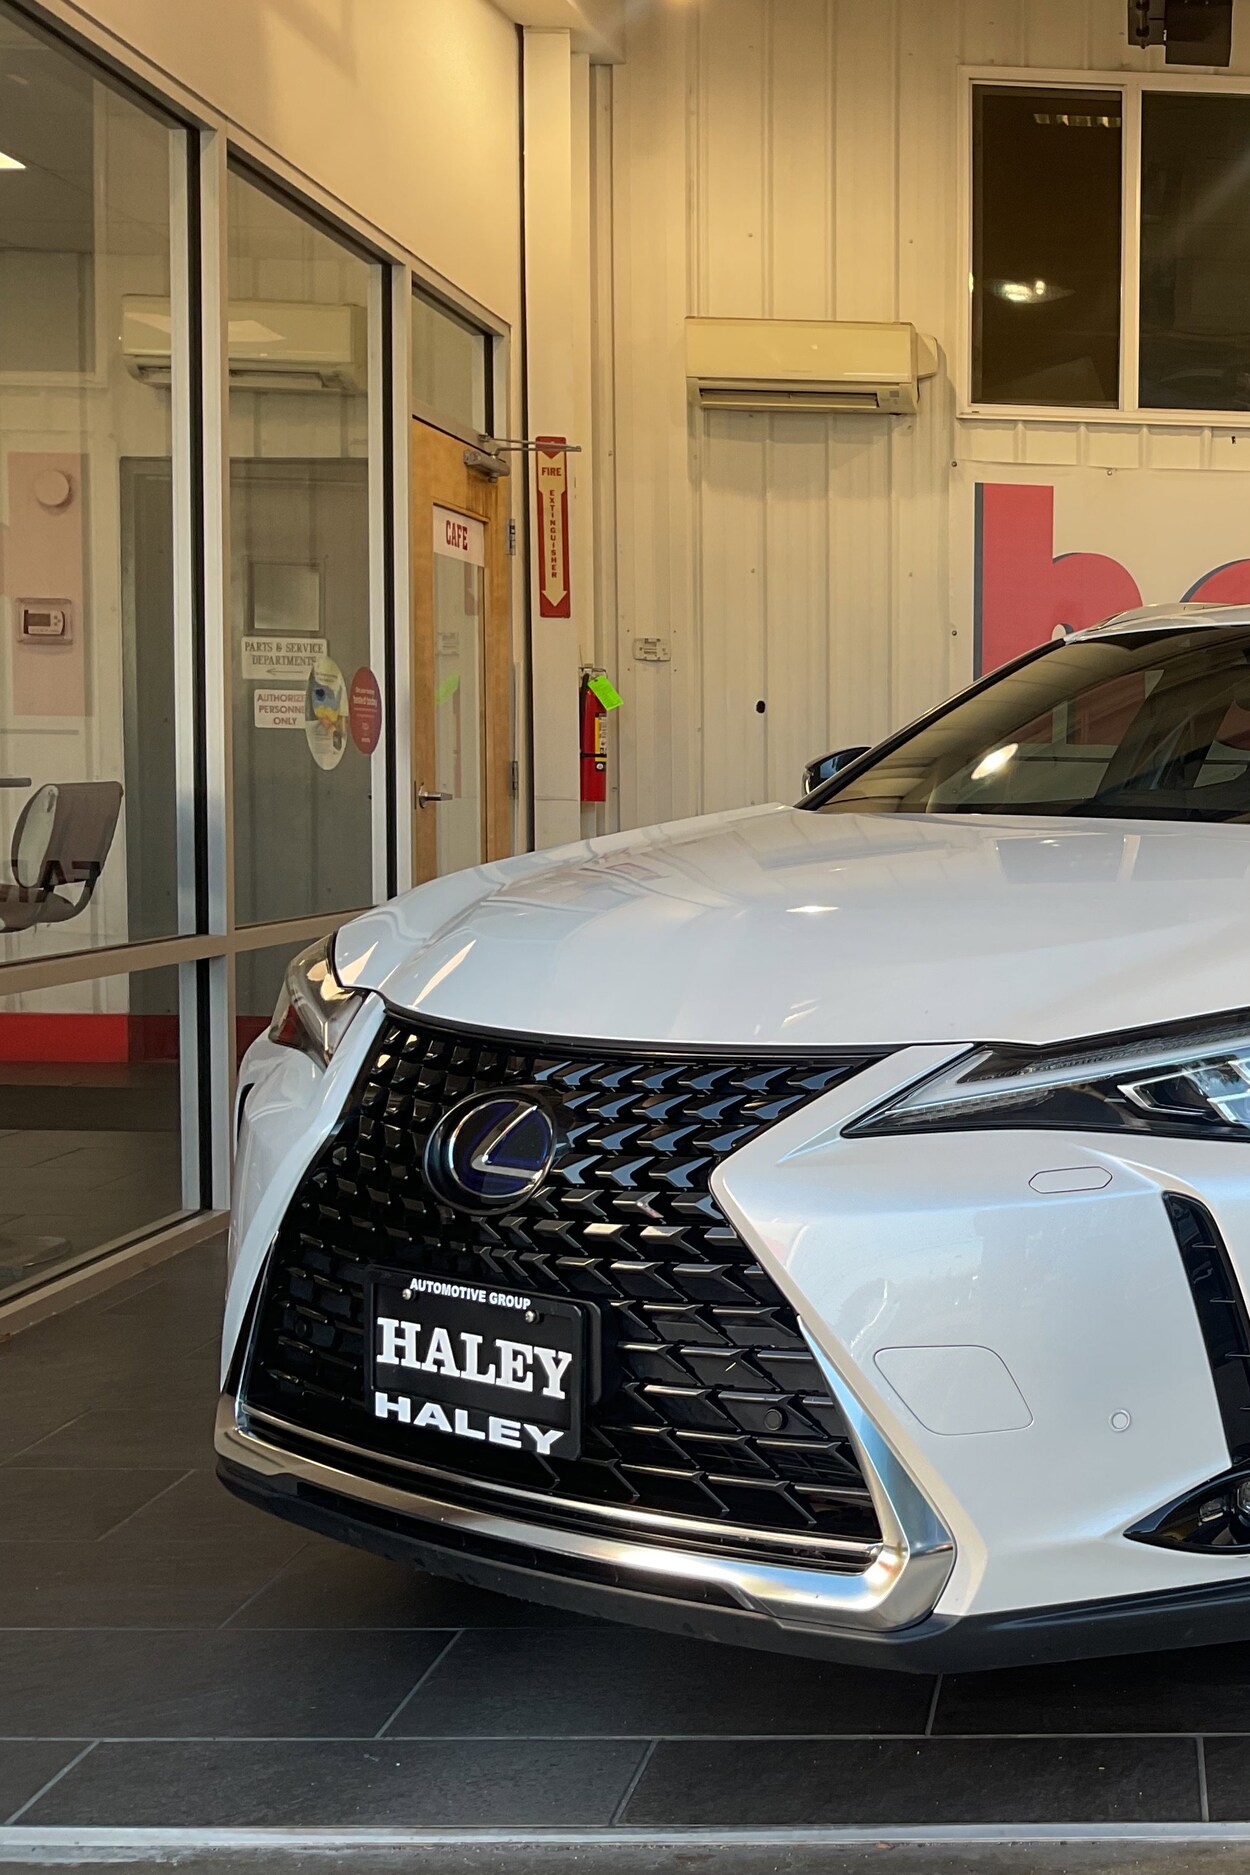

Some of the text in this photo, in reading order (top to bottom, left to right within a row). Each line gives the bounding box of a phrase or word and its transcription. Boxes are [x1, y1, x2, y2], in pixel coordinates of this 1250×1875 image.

[541, 467, 562, 477] FIRE
[445, 519, 468, 550] CAFE
[549, 489, 557, 578] EXTINGUISHER
[244, 641, 323, 653] PARTS & SERVICE
[252, 654, 315, 665] DEPARTMENTS
[273, 717, 298, 726] ONLY
[410, 1277, 531, 1310] AUTOMOTIVE GROUP
[376, 1317, 572, 1400] HALEY
[374, 1391, 564, 1455] HALEY
